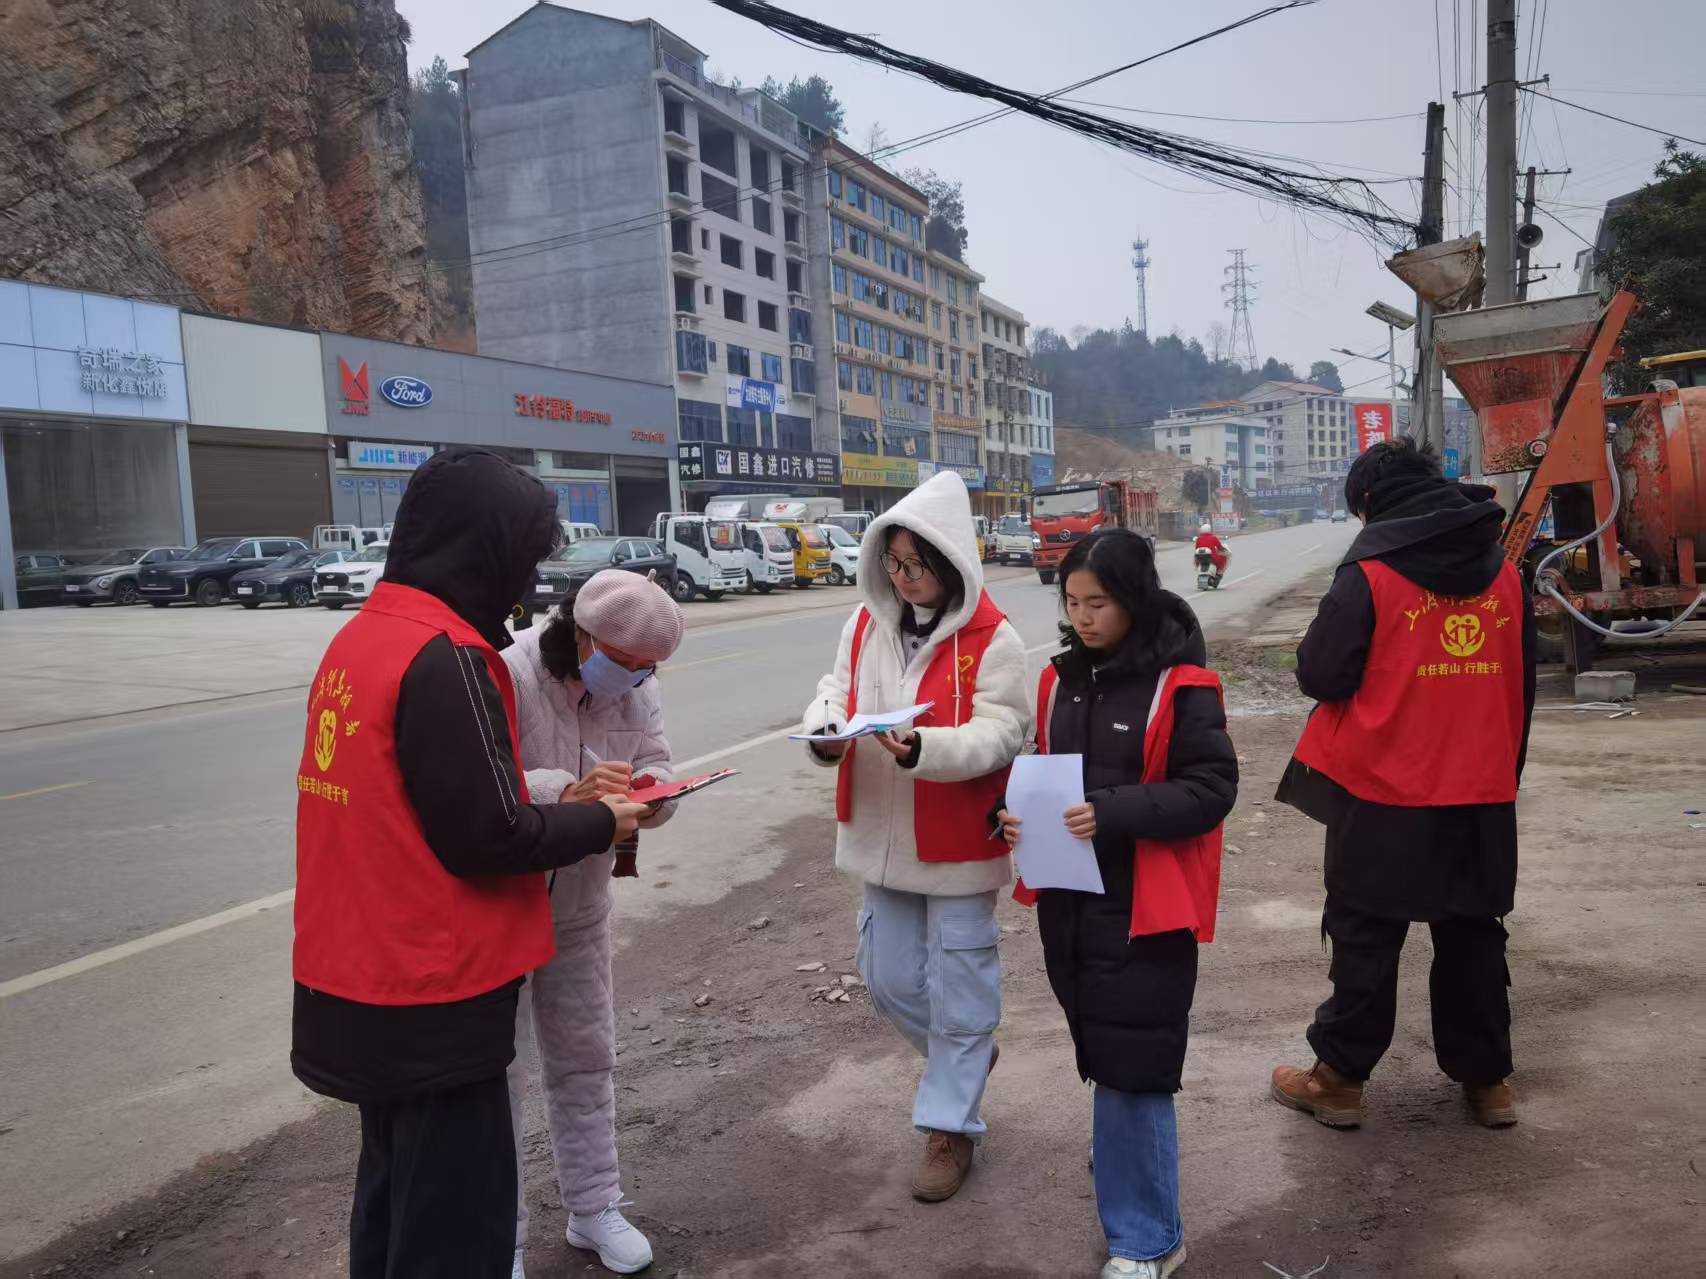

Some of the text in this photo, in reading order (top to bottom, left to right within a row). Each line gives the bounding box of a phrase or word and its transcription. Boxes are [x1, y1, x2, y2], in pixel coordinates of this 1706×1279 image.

[78, 346, 163, 376] 奇瑞之家
[392, 379, 425, 402] Ford
[513, 392, 575, 421] 江铃福特
[738, 452, 815, 479] 国鑫进口汽修
[1416, 662, 1503, 677] 责任若山 行胜于
